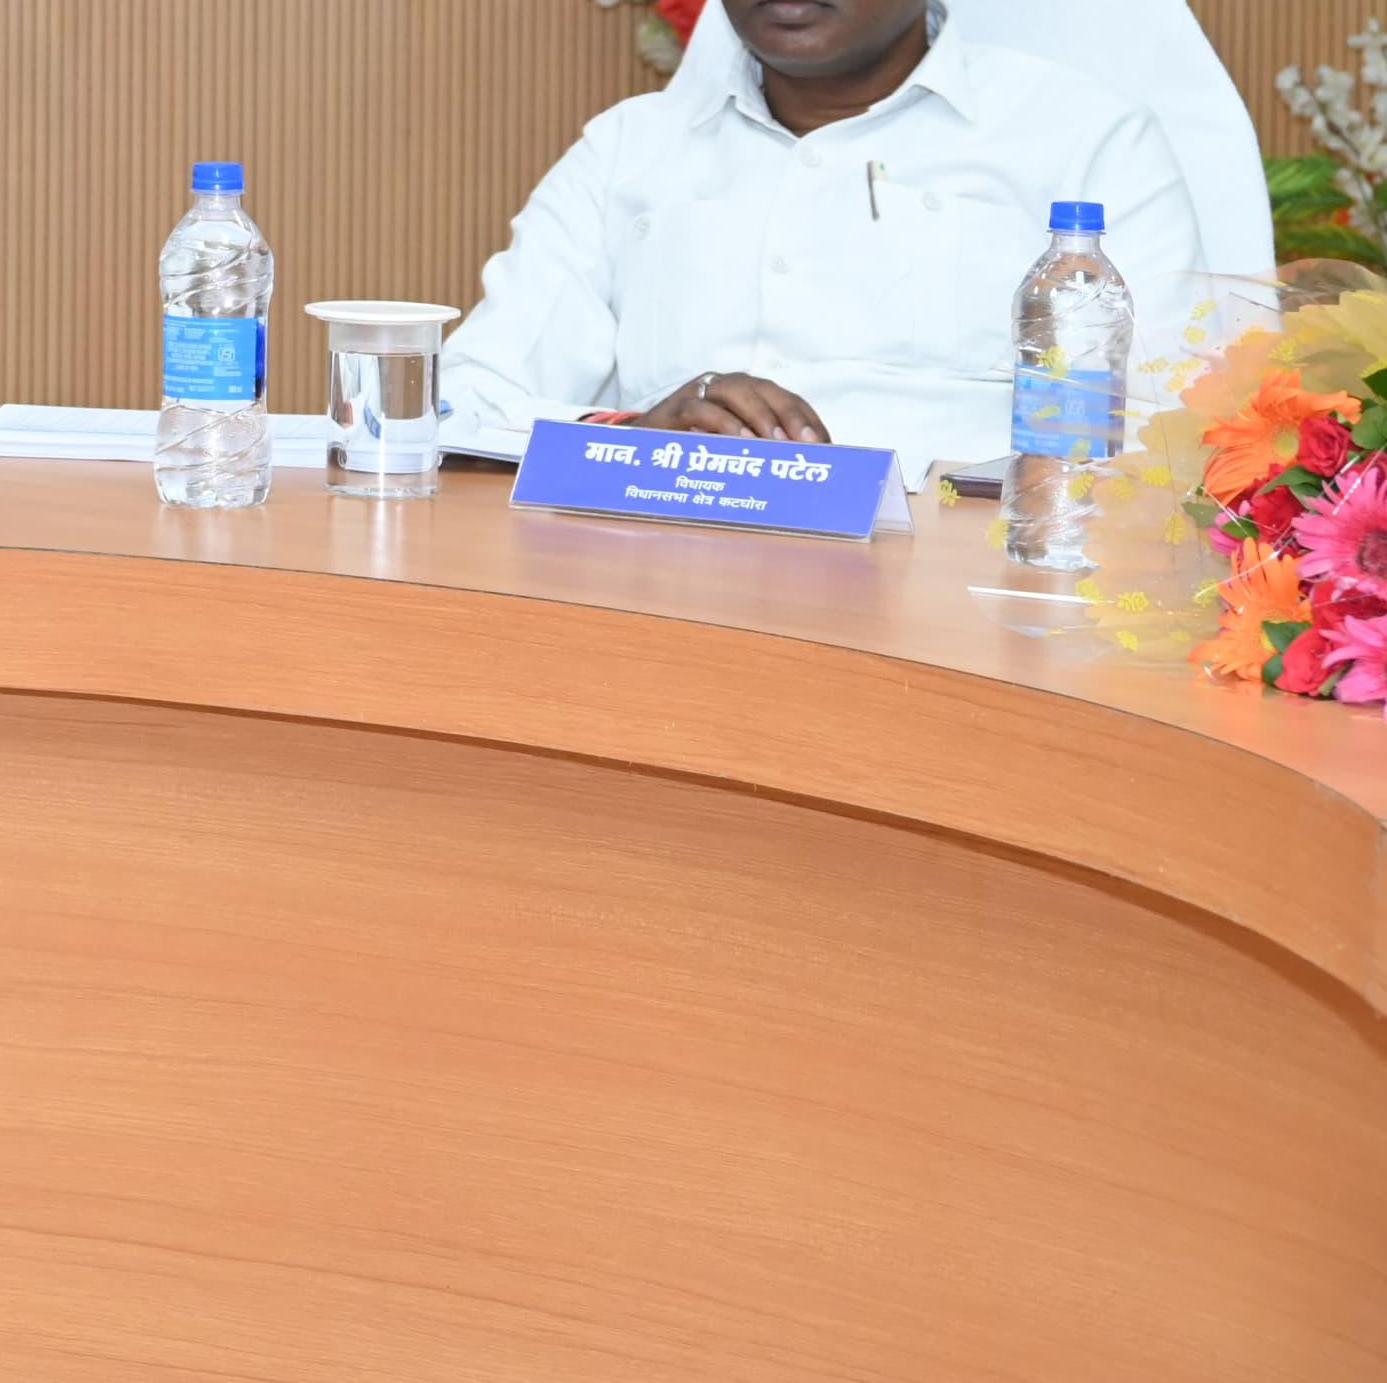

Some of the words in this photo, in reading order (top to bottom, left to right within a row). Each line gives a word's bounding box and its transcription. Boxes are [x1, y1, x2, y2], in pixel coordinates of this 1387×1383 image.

[584, 441, 641, 467] मान.
[651, 442, 683, 470] श्री
[686, 444, 766, 479] प्रेमचंद
[771, 453, 832, 484] पटेल
[675, 475, 726, 492] विधायक
[625, 485, 689, 504] विधानसभा
[692, 492, 716, 506] क्षेत्र
[718, 495, 768, 511] कटघोरा
